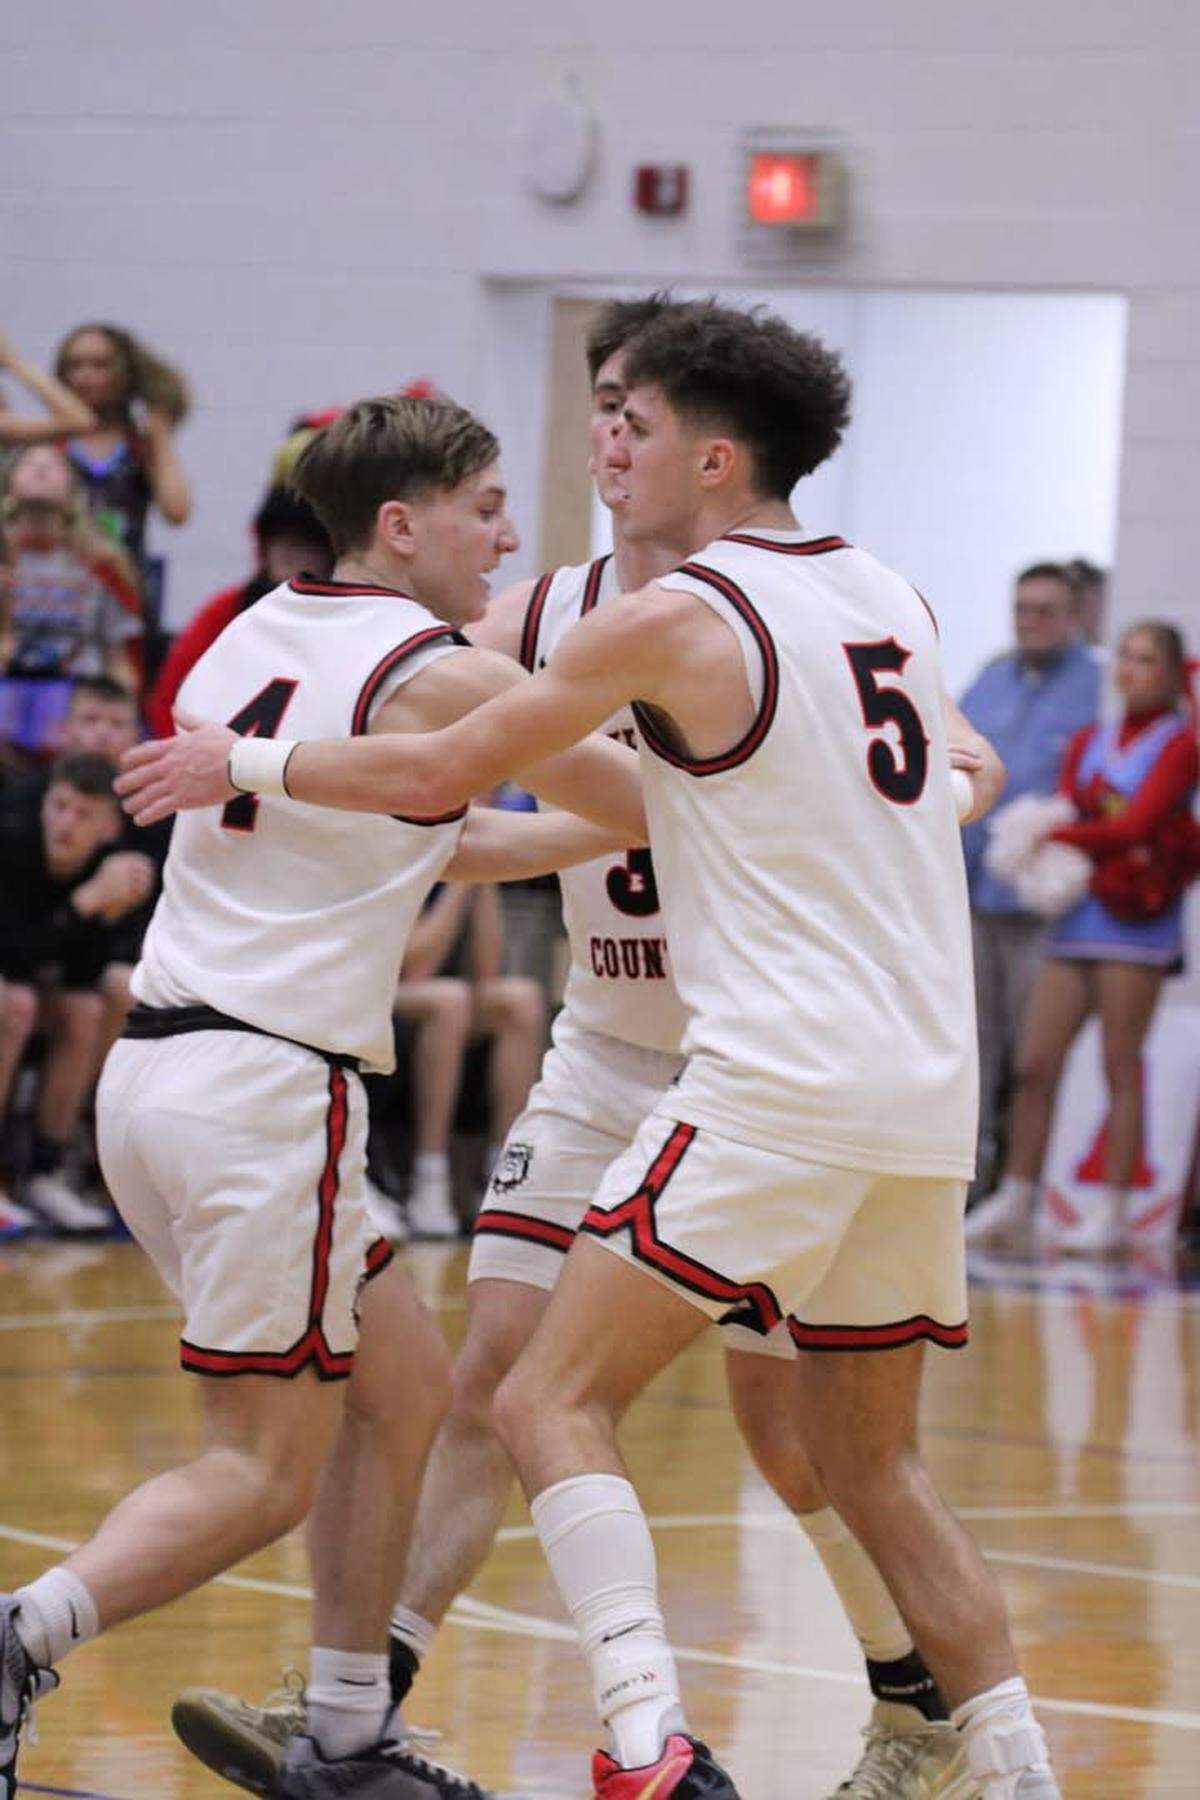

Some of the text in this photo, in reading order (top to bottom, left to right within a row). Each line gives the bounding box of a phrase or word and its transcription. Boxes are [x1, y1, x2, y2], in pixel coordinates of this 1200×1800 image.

[220, 677, 299, 832] 4
[840, 635, 930, 806] 5
[590, 935, 668, 980] COUN
